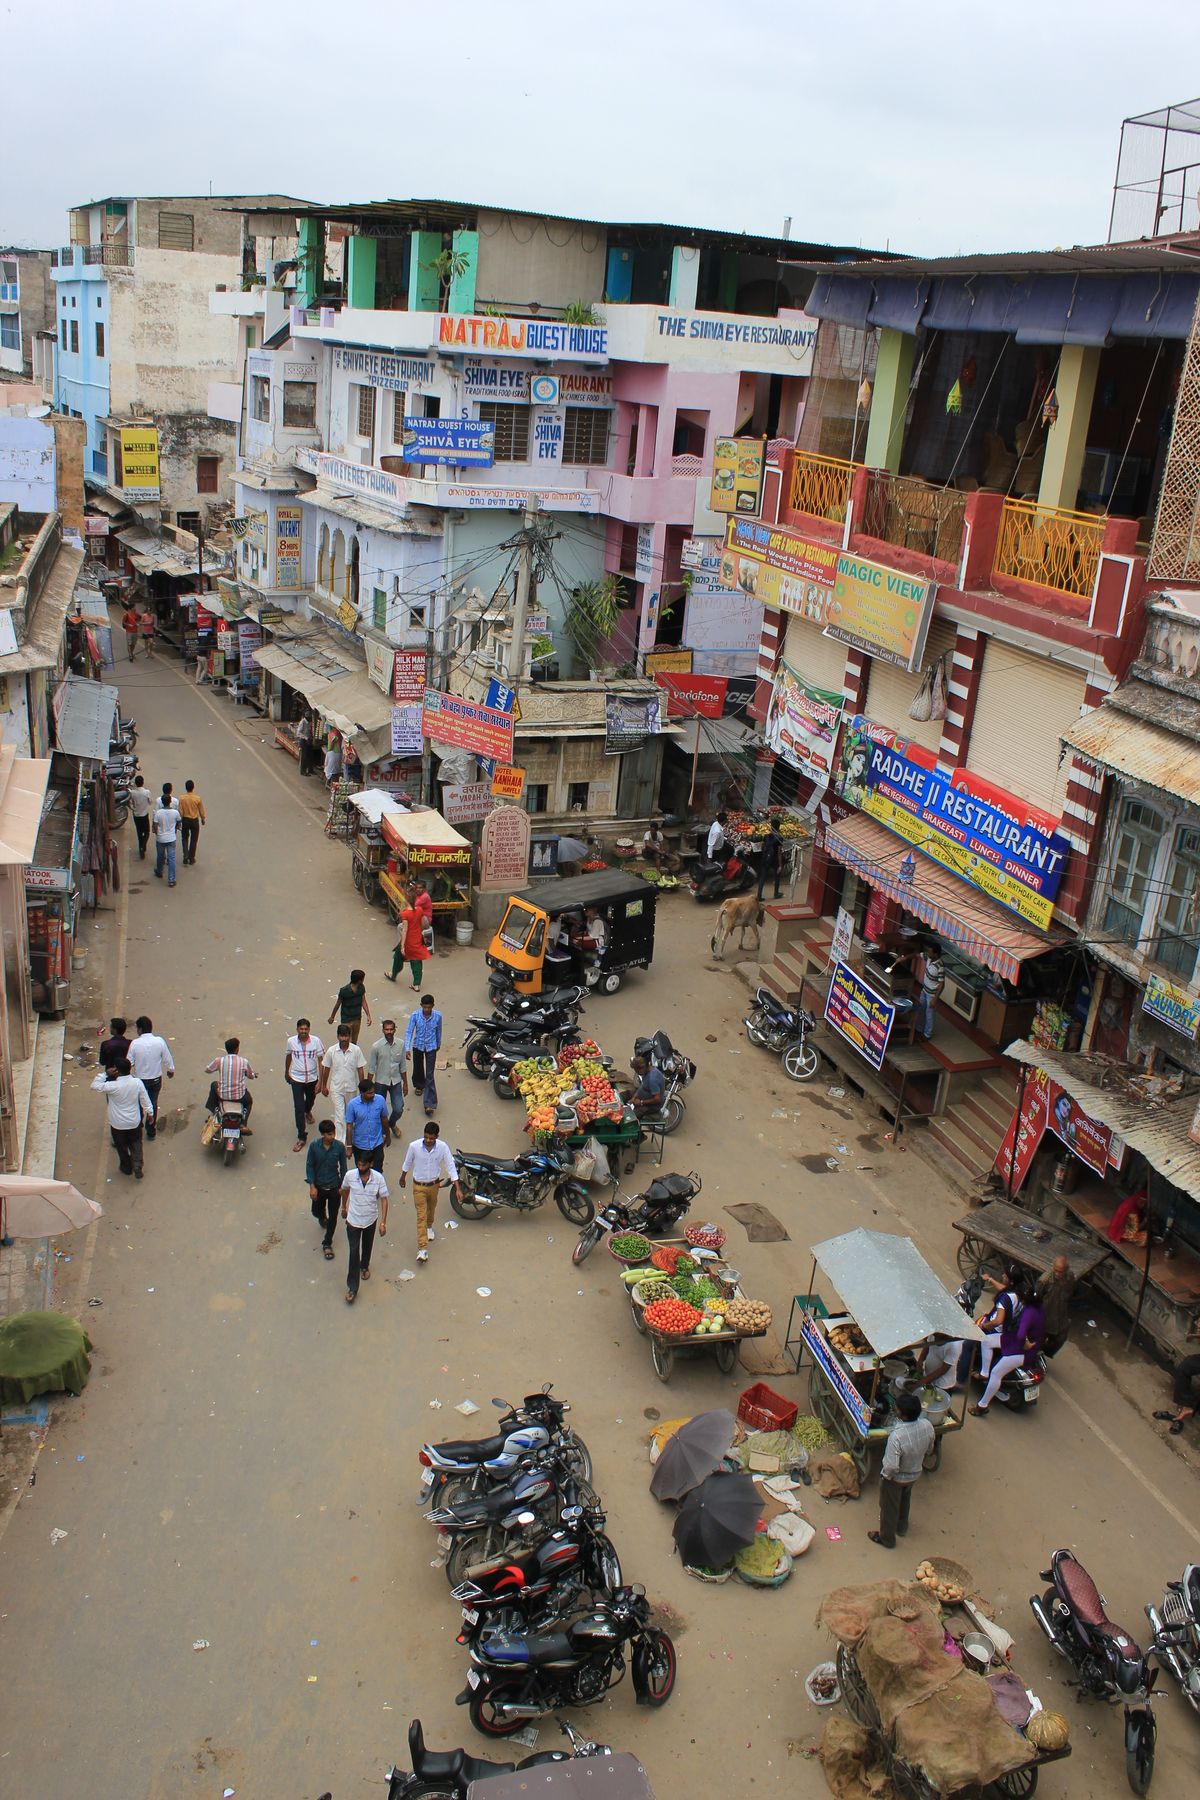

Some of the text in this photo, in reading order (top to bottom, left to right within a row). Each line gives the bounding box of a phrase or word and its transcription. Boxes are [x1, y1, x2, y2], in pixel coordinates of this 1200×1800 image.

[439, 317, 608, 355] NATRAJ GUEST HOUSE
[658, 315, 687, 337] THE
[690, 319, 724, 341] SHIVA
[725, 323, 750, 343] EYE
[342, 351, 364, 371] SHIVA
[364, 354, 379, 375] EYE
[380, 356, 436, 384] RESTAURANT
[468, 358, 481, 367] THE
[371, 375, 410, 391] PIZZERIA
[464, 367, 523, 388] SHIVA EYE
[465, 386, 499, 397] TRADITIONAL
[407, 419, 491, 432] NATRAJ GUEST HOUSE
[535, 425, 561, 440] SHIVA
[418, 436, 479, 449] SHIVA EYE
[539, 442, 558, 459] EYE
[278, 520, 300, 537] INTERNET
[280, 540, 287, 550] 8
[736, 520, 754, 541] MAGIC
[805, 544, 838, 569] RESTAURANT
[701, 557, 722, 568] GUE
[739, 540, 824, 575] The Real Wood Fire Pizza
[770, 558, 836, 586] The Best Indian Food
[837, 557, 925, 604] MAGIC VIEW
[396, 656, 411, 664] MILK
[879, 647, 893, 661] Good
[412, 663, 426, 671] HOUSE
[495, 684, 509, 712] LACE
[673, 690, 719, 702] vodafone
[495, 766, 512, 775] HOTEL
[879, 782, 892, 795] PURE
[459, 794, 481, 802] VARAH
[832, 803, 847, 818] AXIS
[871, 749, 926, 797] RADHE
[923, 782, 940, 808] JI
[941, 790, 1063, 874] RESTAURANT
[896, 810, 910, 823] COLD
[922, 810, 965, 841] BRAKEFAST
[409, 848, 471, 864] पोदीना जलजीरा
[933, 847, 942, 857] ICE
[969, 839, 1000, 865] LUNCH
[980, 863, 998, 878] PASTRY
[1004, 861, 1041, 888] DINNER
[25, 878, 58, 886] ALACE.
[984, 881, 1008, 901] SAMBHAR
[1007, 881, 1048, 911] BIRTHDAY CAKE
[501, 942, 517, 955] ATUL
[629, 957, 648, 966] ATUL
[836, 969, 854, 995] South
[853, 984, 872, 1012] Indian
[872, 1003, 889, 1027] Food
[1147, 990, 1197, 1028] LAUNDRY
